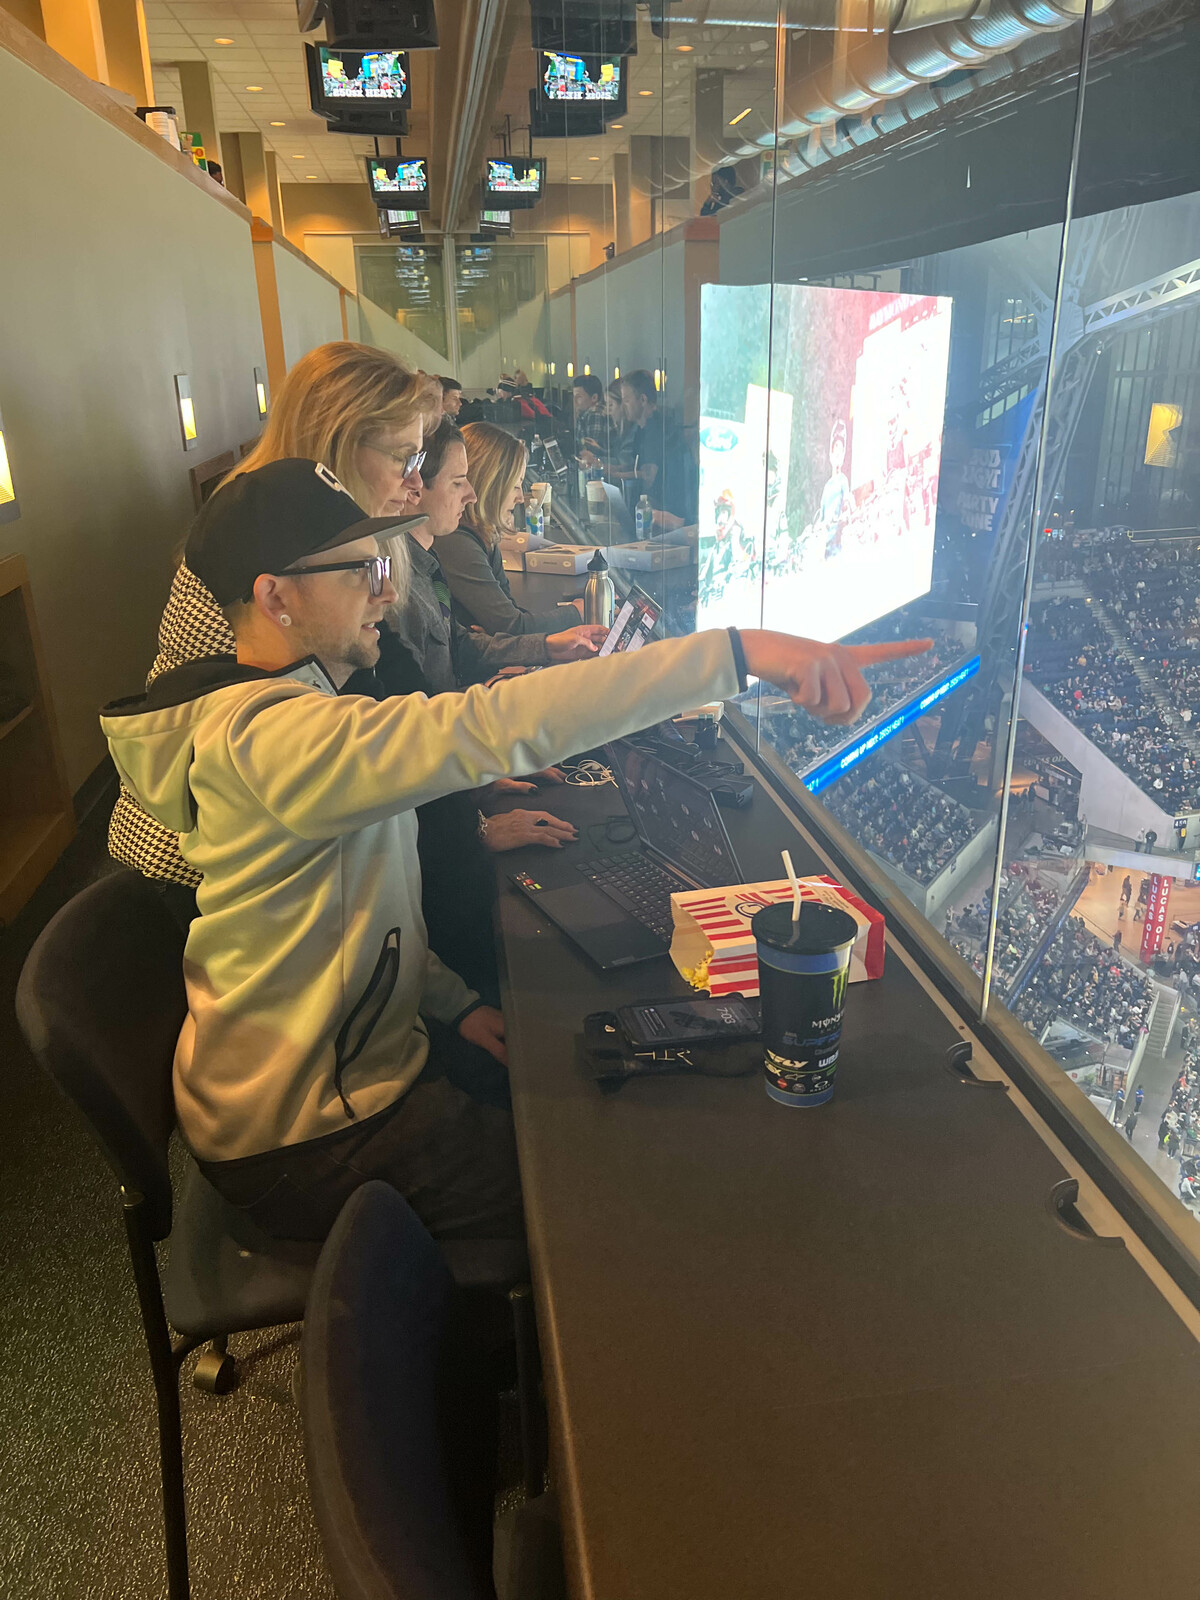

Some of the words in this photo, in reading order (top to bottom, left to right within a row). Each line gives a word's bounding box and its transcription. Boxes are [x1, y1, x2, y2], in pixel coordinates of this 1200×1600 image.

[365, 88, 394, 98] HEAT
[957, 491, 999, 514] PARTY
[841, 748, 859, 768] COMING
[860, 743, 866, 755] UP
[1148, 876, 1158, 920] LUCAS
[1158, 879, 1169, 922] LUCAS
[1144, 923, 1152, 949] OIL
[1153, 926, 1163, 951] OIL
[717, 1007, 736, 1025] 7:03
